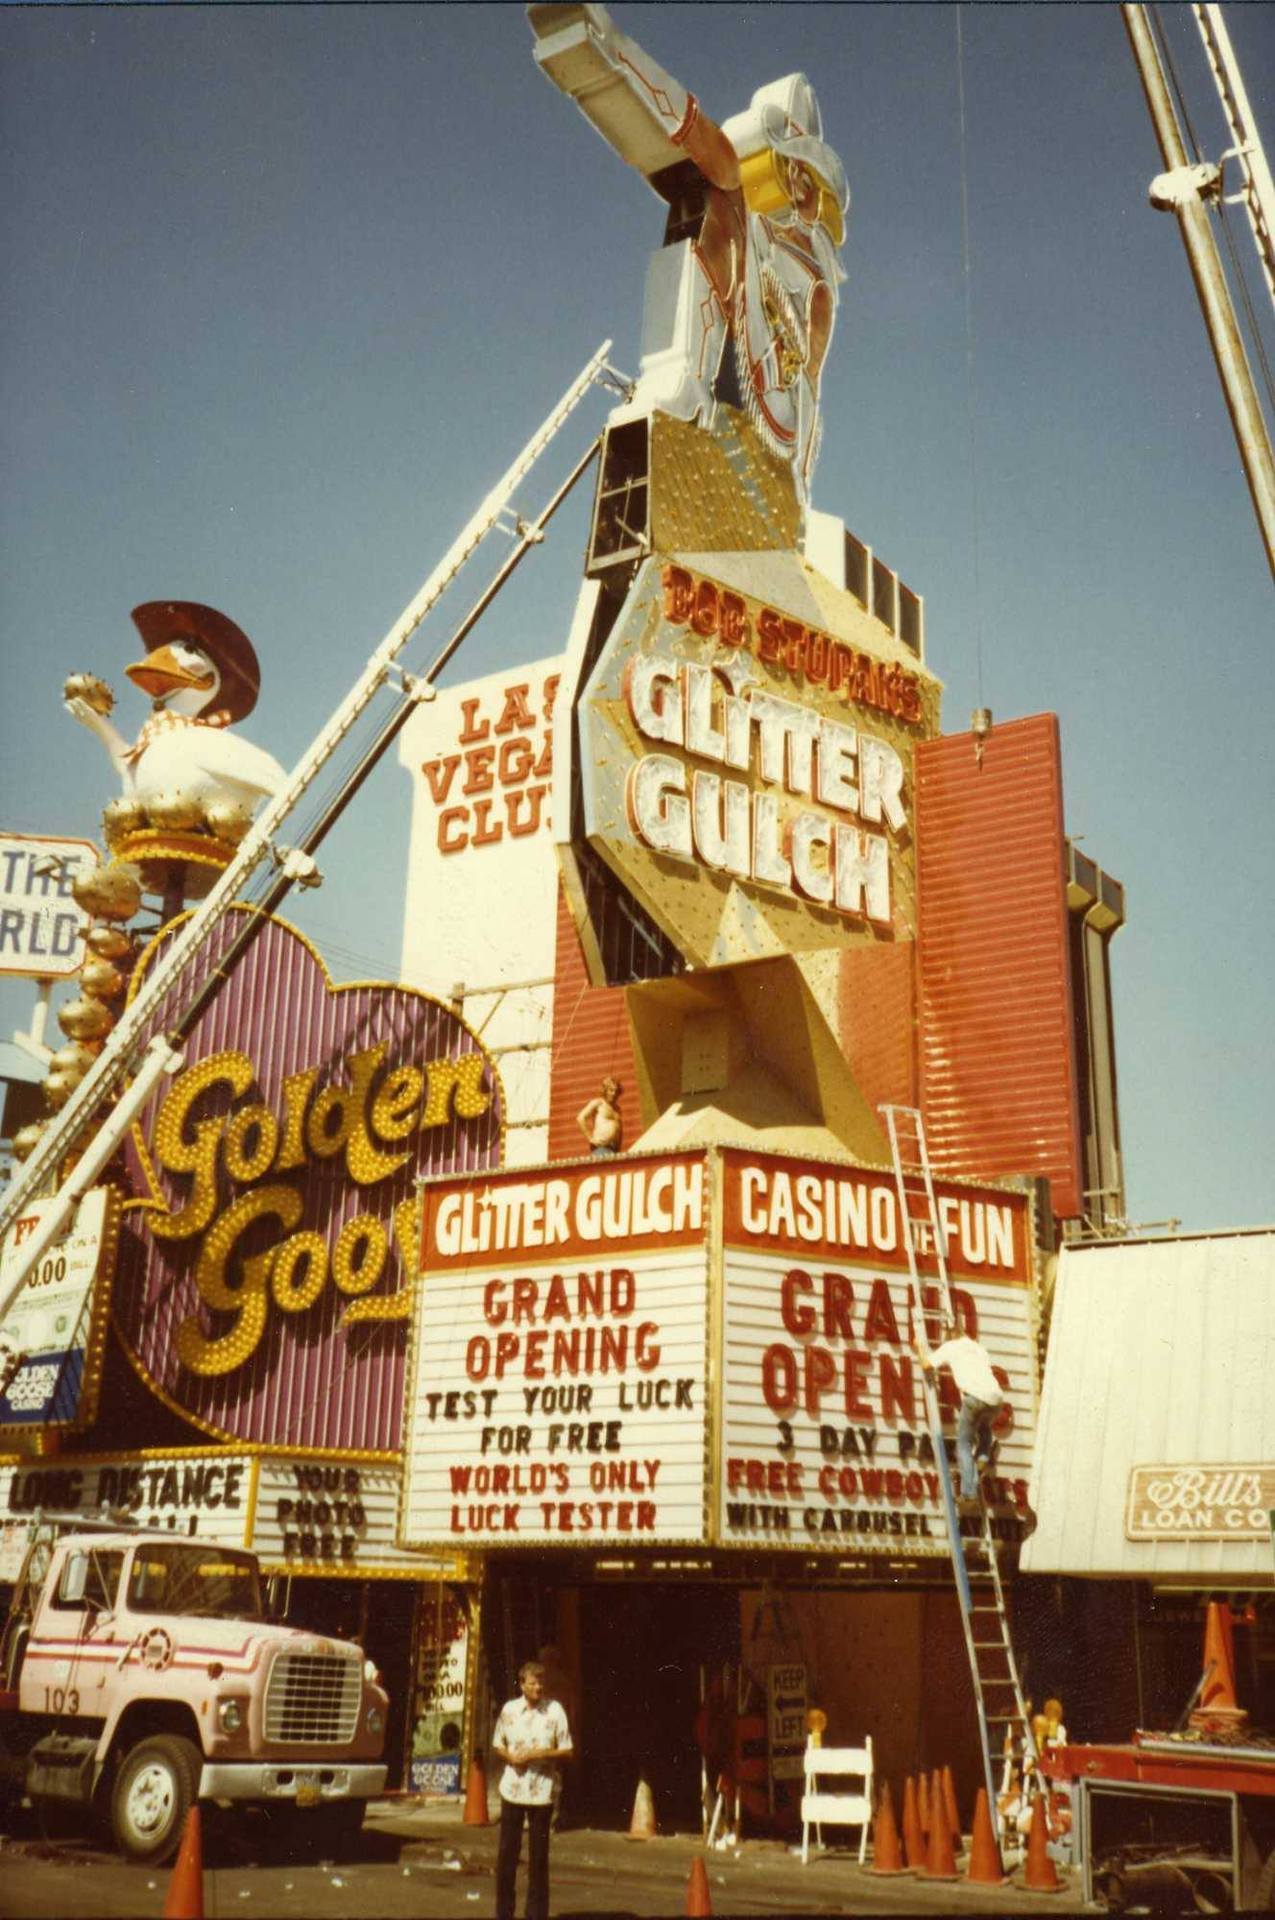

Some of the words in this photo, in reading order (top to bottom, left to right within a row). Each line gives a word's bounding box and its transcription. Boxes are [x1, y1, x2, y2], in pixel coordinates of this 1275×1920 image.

[622, 650, 906, 834] GLITTER
[437, 782, 553, 857] CLU
[626, 752, 892, 924] GULCH
[0, 908, 79, 957] RLD
[144, 1040, 494, 1240] Golden
[435, 1179, 571, 1256] GLITTER
[575, 1164, 702, 1242] GULCH
[740, 1166, 897, 1252] CASINO
[937, 1196, 1015, 1269] FUN
[483, 1268, 637, 1328] GRAND
[466, 1322, 661, 1382] OPENING
[427, 1389, 498, 1421] TEST
[522, 1384, 593, 1414] YOUR
[618, 1378, 695, 1412] LUCK
[481, 1425, 532, 1456] FOR
[547, 1420, 623, 1453] FREE
[777, 1420, 794, 1452] 3
[820, 1424, 876, 1460] DAY
[97, 1464, 243, 1513] DISTANCE
[294, 1465, 360, 1495] YOUR
[449, 1463, 571, 1496] WORLD'S
[589, 1459, 661, 1495] ONLY
[727, 1458, 801, 1497] FREE
[819, 1465, 939, 1505] COWBOY
[450, 1502, 520, 1533] LUCK
[540, 1501, 656, 1533] TESTER
[726, 1502, 790, 1534] WITH
[803, 1509, 933, 1537] CAROUSEL
[1141, 1509, 1214, 1529] LOAN
[283, 1532, 357, 1561] FREE
[44, 1686, 80, 1714] 103
